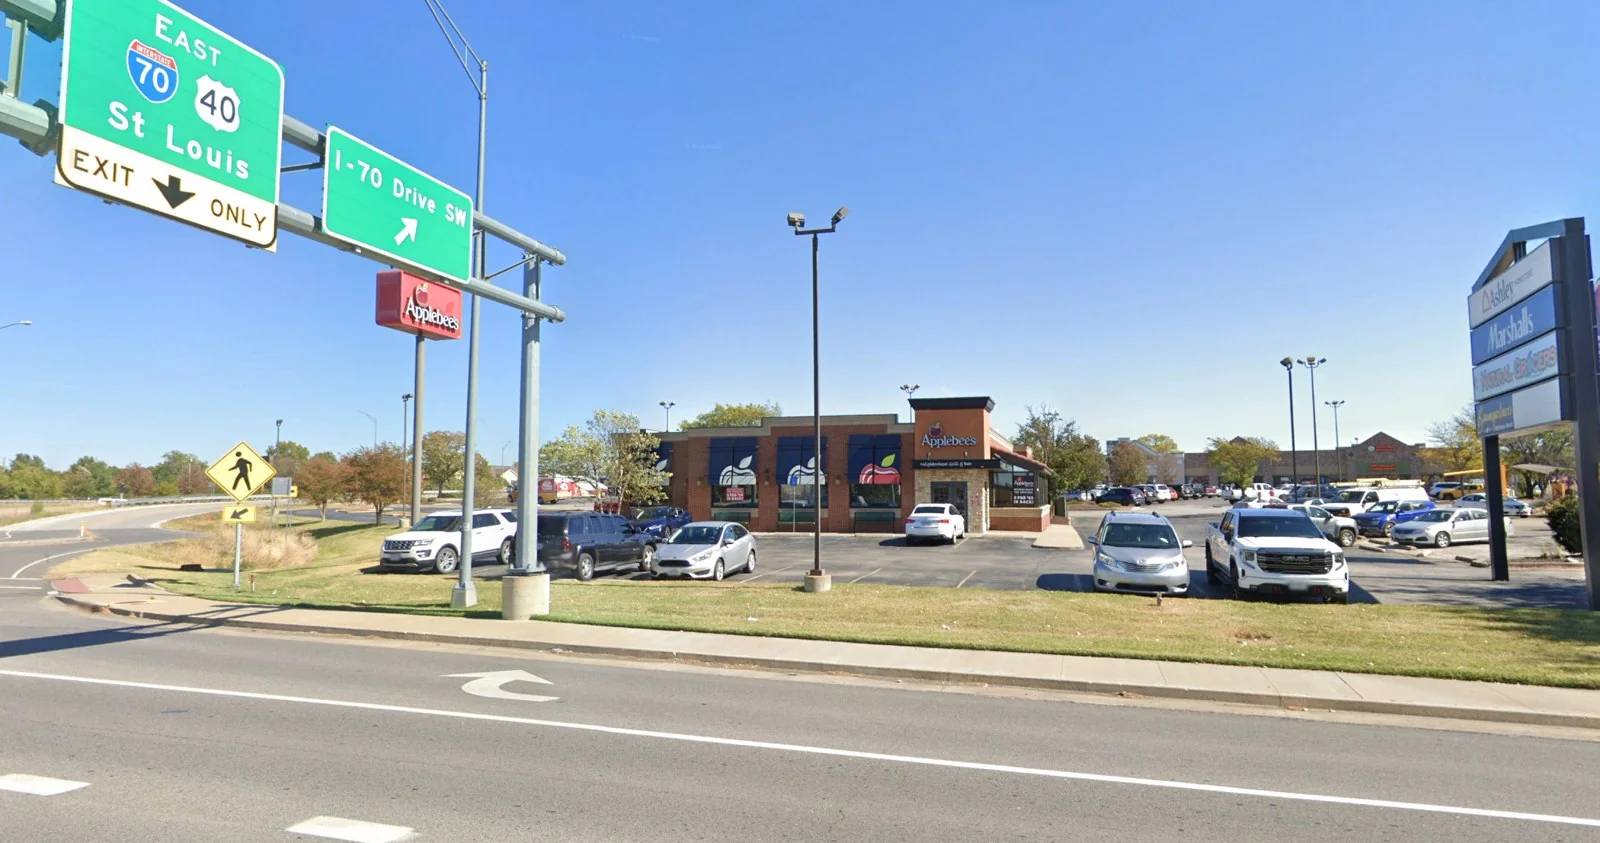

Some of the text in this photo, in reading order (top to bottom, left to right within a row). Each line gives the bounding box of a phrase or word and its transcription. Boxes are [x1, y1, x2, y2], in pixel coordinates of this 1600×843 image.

[136, 44, 173, 67] INTERSTATE
[155, 13, 222, 67] EAST
[136, 57, 170, 94] 70
[200, 89, 236, 124] 40
[108, 101, 249, 179] St Louis
[74, 149, 267, 231] EXIT ONLY
[335, 149, 467, 228] I-70 Drive SW
[1489, 279, 1514, 308] Ashley
[405, 296, 459, 330] Applebee's
[1487, 306, 1534, 354] Marshalls
[921, 433, 977, 449] Applebee's
